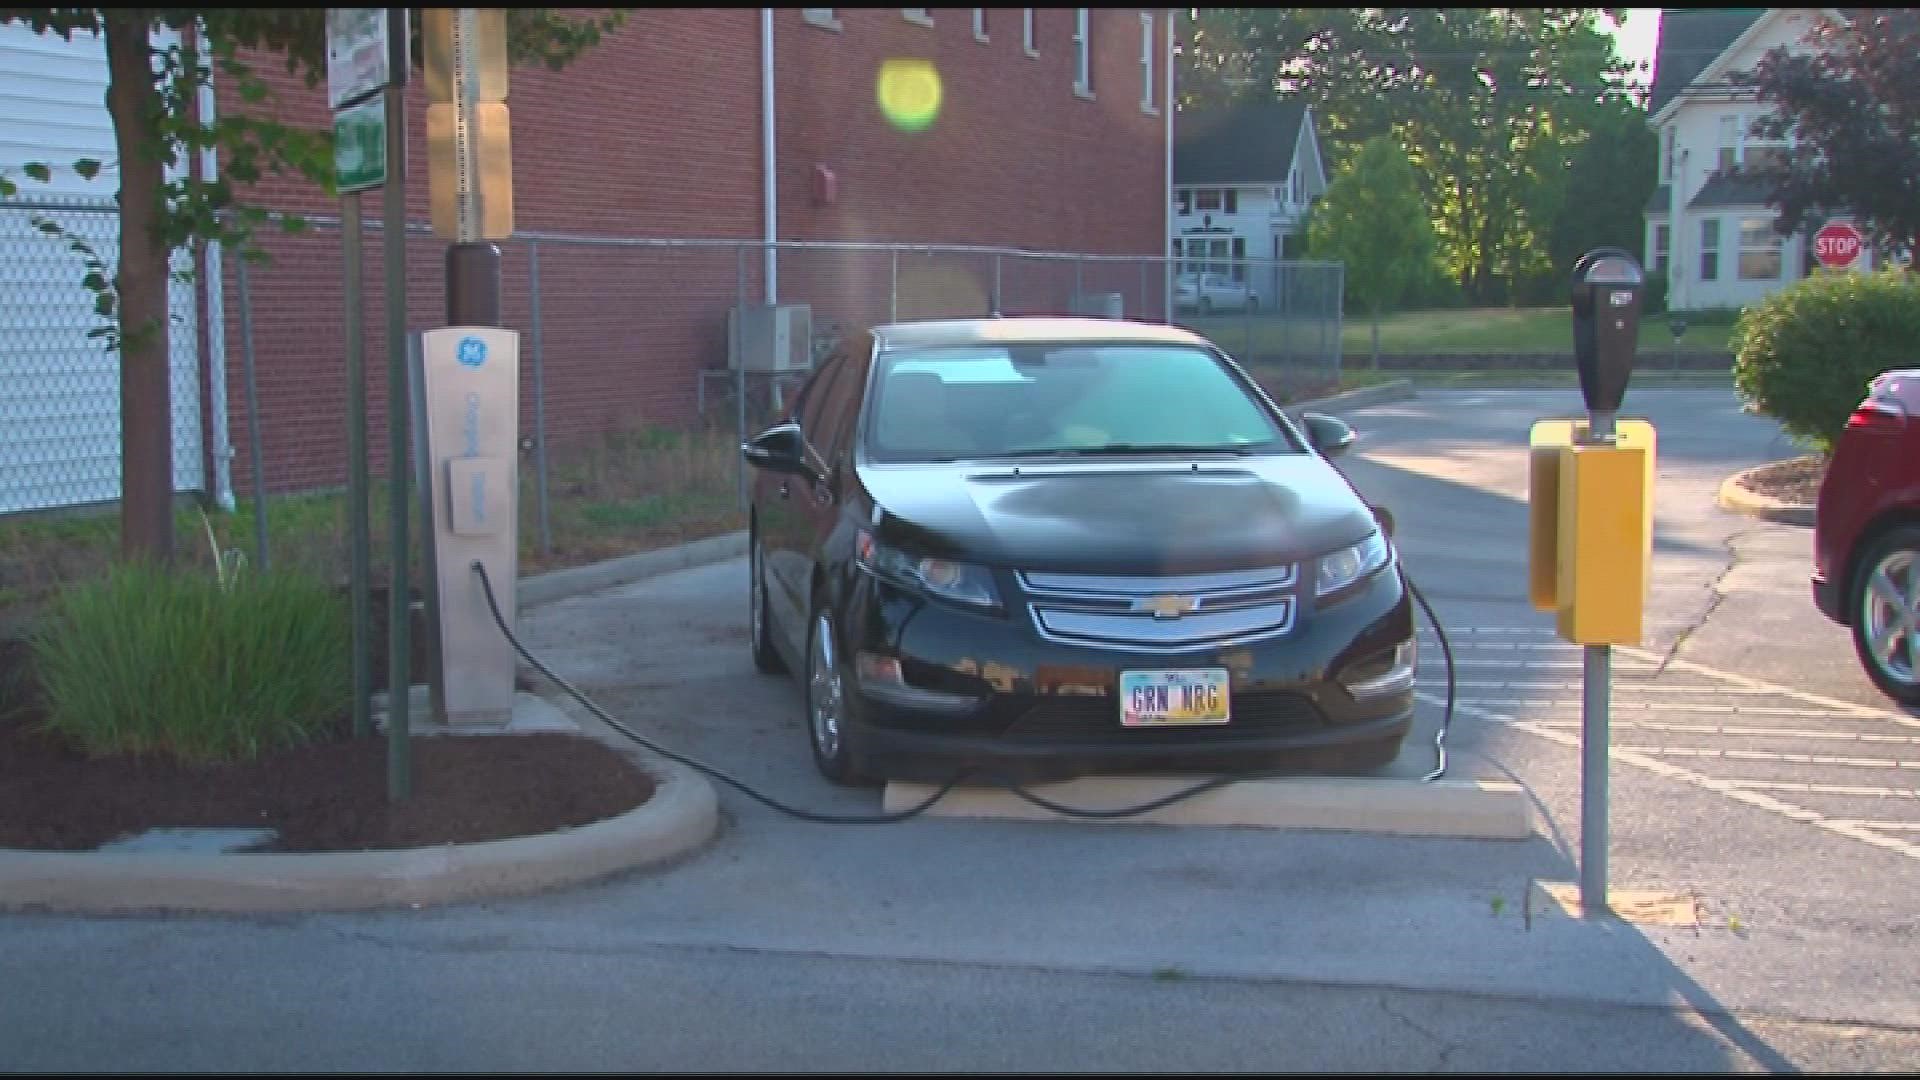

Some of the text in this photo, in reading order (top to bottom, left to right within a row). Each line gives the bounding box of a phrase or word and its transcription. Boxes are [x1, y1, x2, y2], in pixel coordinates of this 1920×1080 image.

[1816, 236, 1857, 254] STOP
[1132, 684, 1218, 712] GRN NRG
